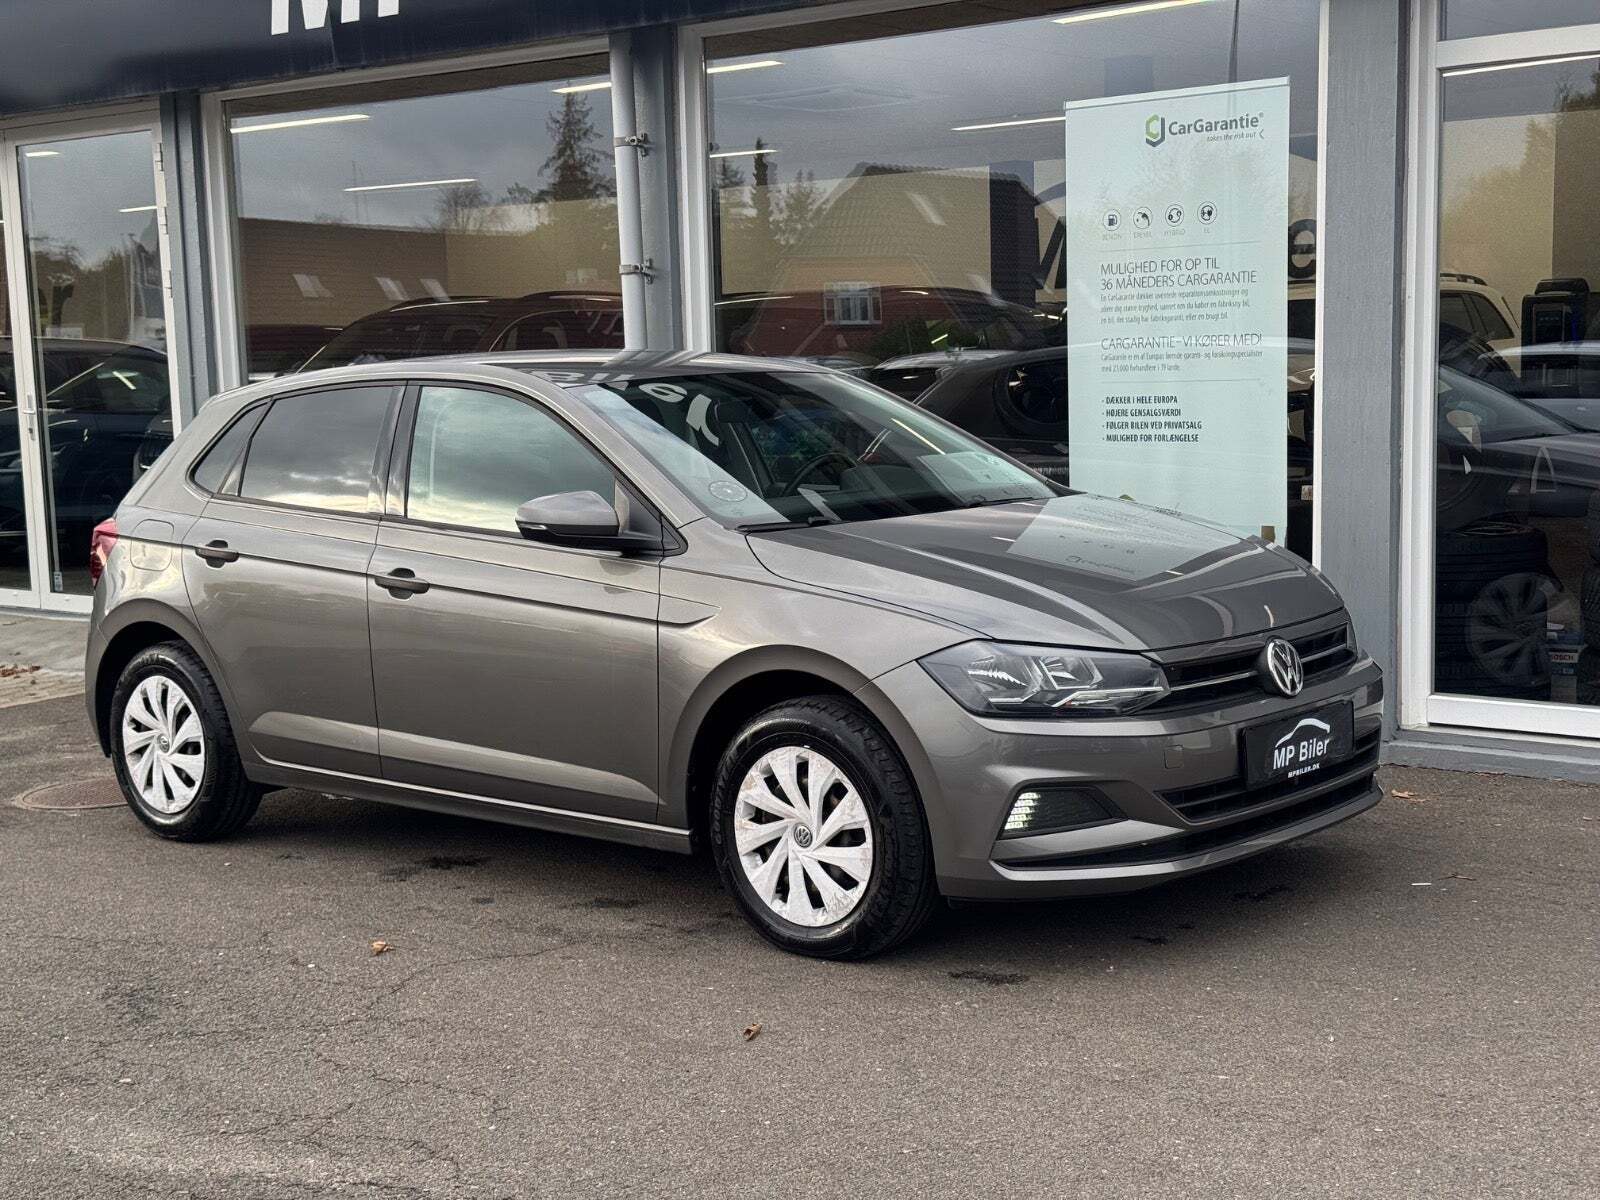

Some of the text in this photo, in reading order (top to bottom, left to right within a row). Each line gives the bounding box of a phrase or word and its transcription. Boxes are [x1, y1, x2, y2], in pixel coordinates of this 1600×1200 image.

[1101, 257, 1220, 275] MULIGHED FOR OP TIL
[1101, 270, 1257, 291] 36 MÅNEDERS CARGARANTIE
[1196, 334, 1230, 348] KØRER
[1234, 333, 1262, 346] MED!
[1106, 396, 1131, 404] DÆKKER
[1136, 396, 1153, 404] HELE
[1153, 395, 1178, 404] EUROPA
[1106, 408, 1181, 417] HØJERE GENSALGSVÆRDI
[1106, 421, 1202, 430] FØLGER BILEN VED PRIVATSALG
[1106, 434, 1199, 442] MULIGHED FOR FORLÆNGELSE
[1273, 738, 1331, 769] MP Biler
[1288, 762, 1320, 778] MPBILER.DK
